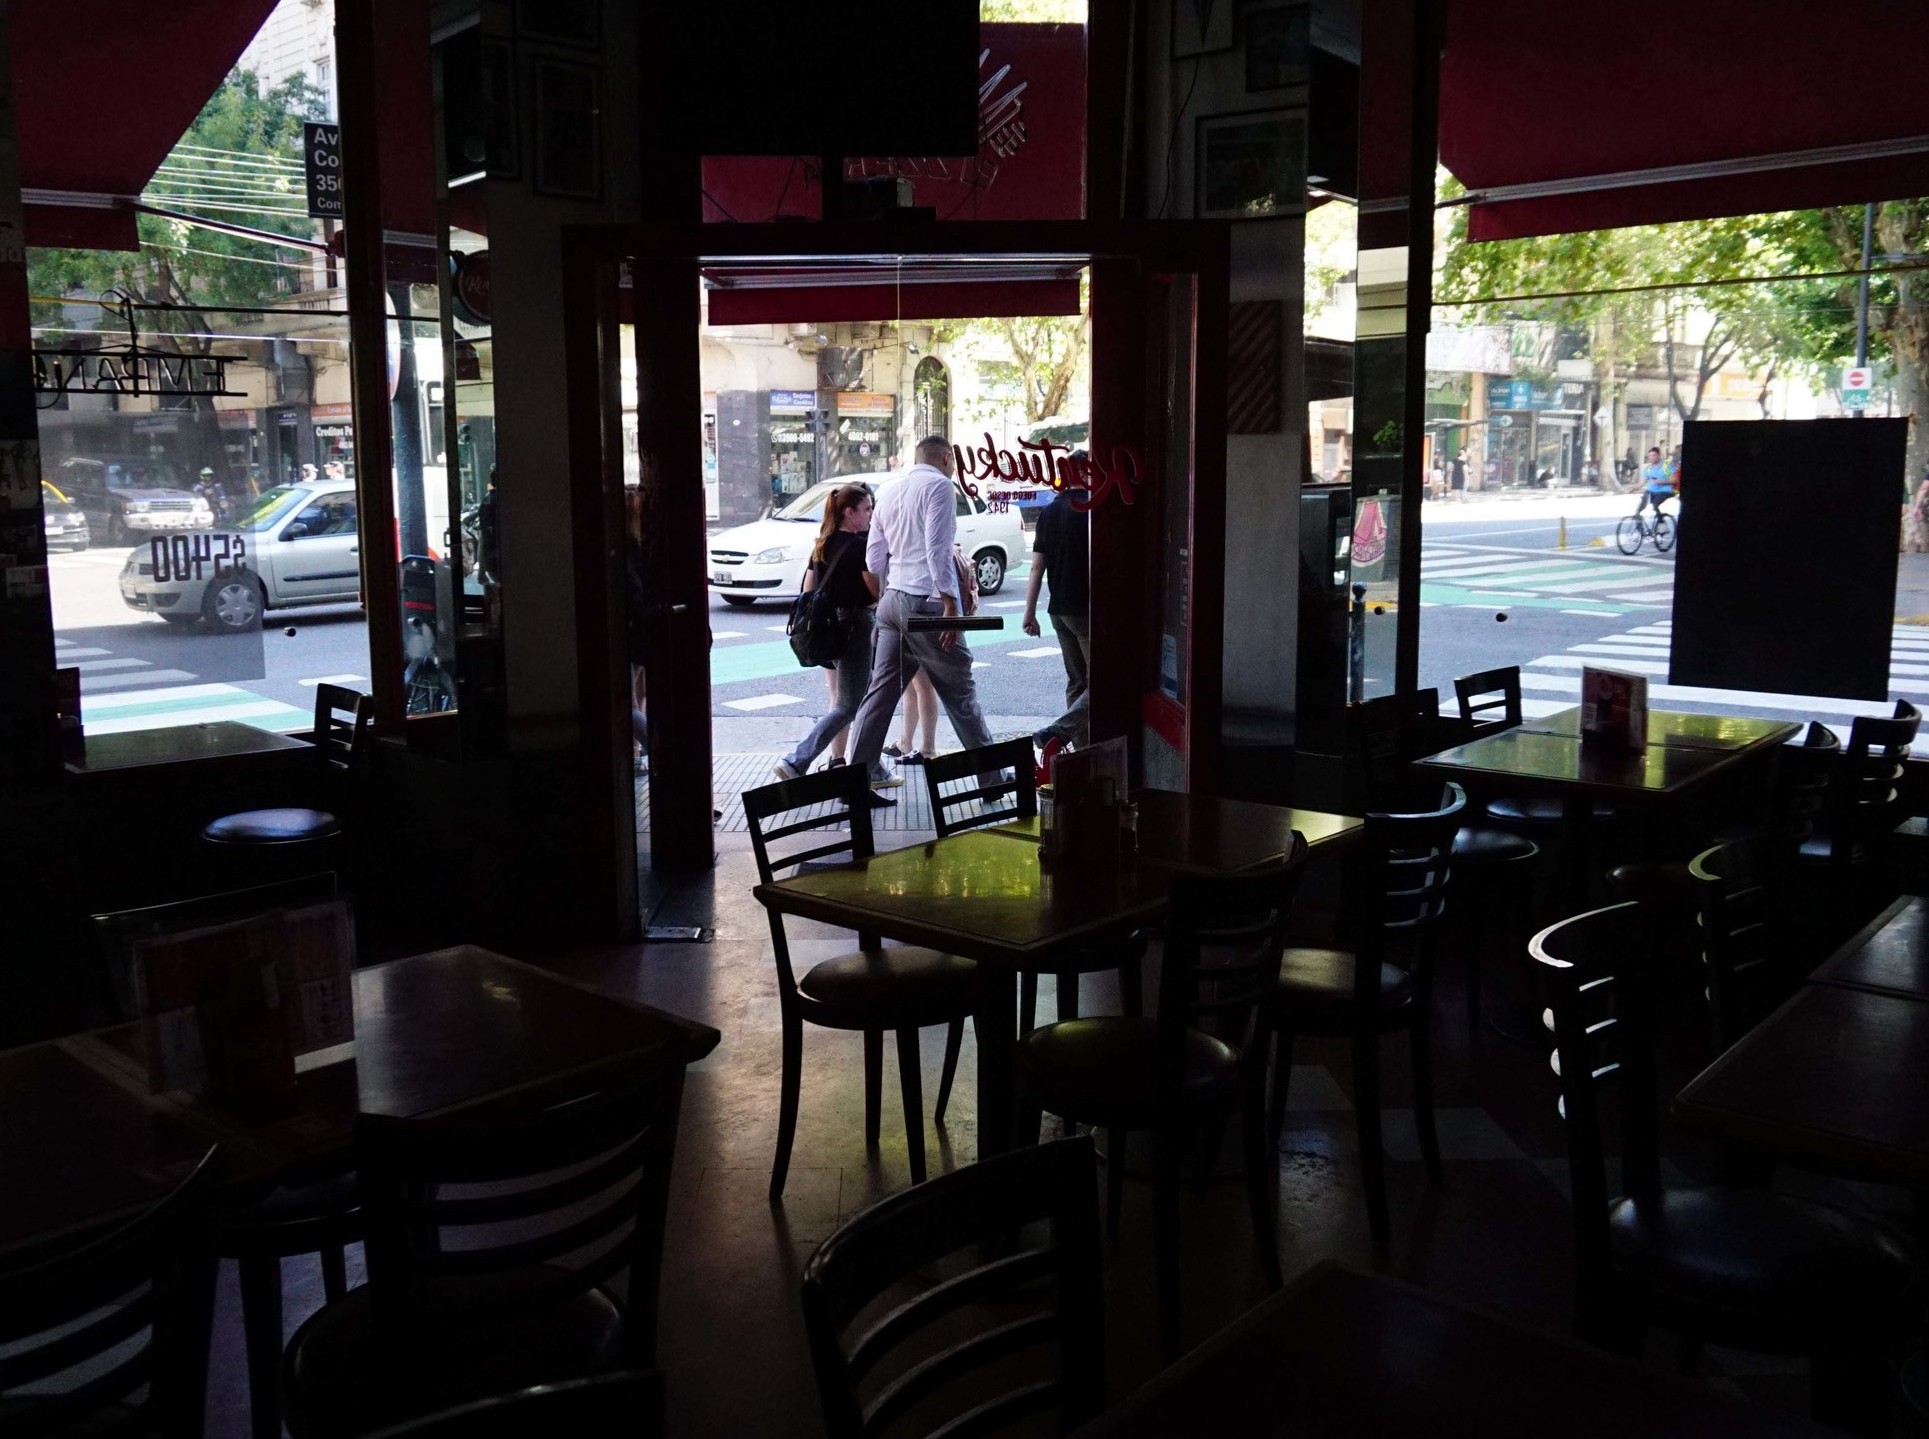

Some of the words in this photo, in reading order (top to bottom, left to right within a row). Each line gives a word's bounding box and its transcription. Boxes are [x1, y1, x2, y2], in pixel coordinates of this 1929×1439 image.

[313, 127, 338, 145] Av
[313, 149, 339, 168] Co
[315, 174, 341, 191] 35
